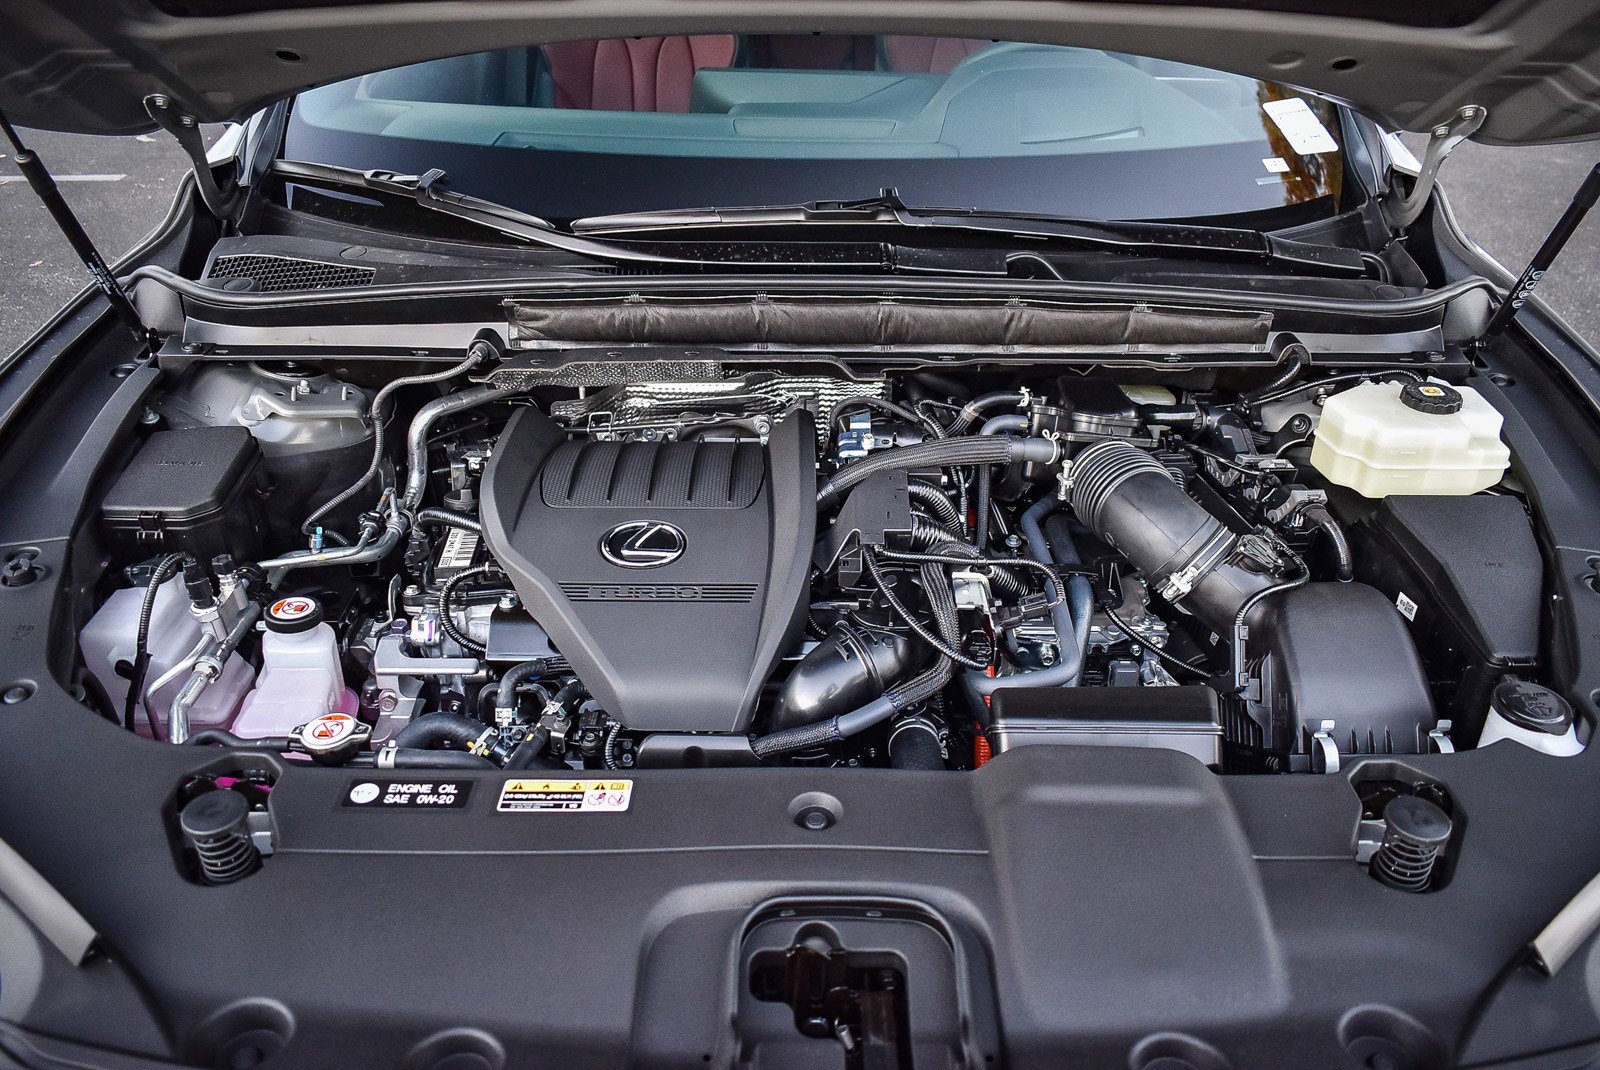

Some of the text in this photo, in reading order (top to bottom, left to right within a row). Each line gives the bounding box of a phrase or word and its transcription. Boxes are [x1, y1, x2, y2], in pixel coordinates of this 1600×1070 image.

[592, 585, 699, 599] TURBO
[387, 783, 434, 794] ENGINE
[437, 783, 459, 794] OIL
[382, 794, 456, 805] SAE 0W-20
